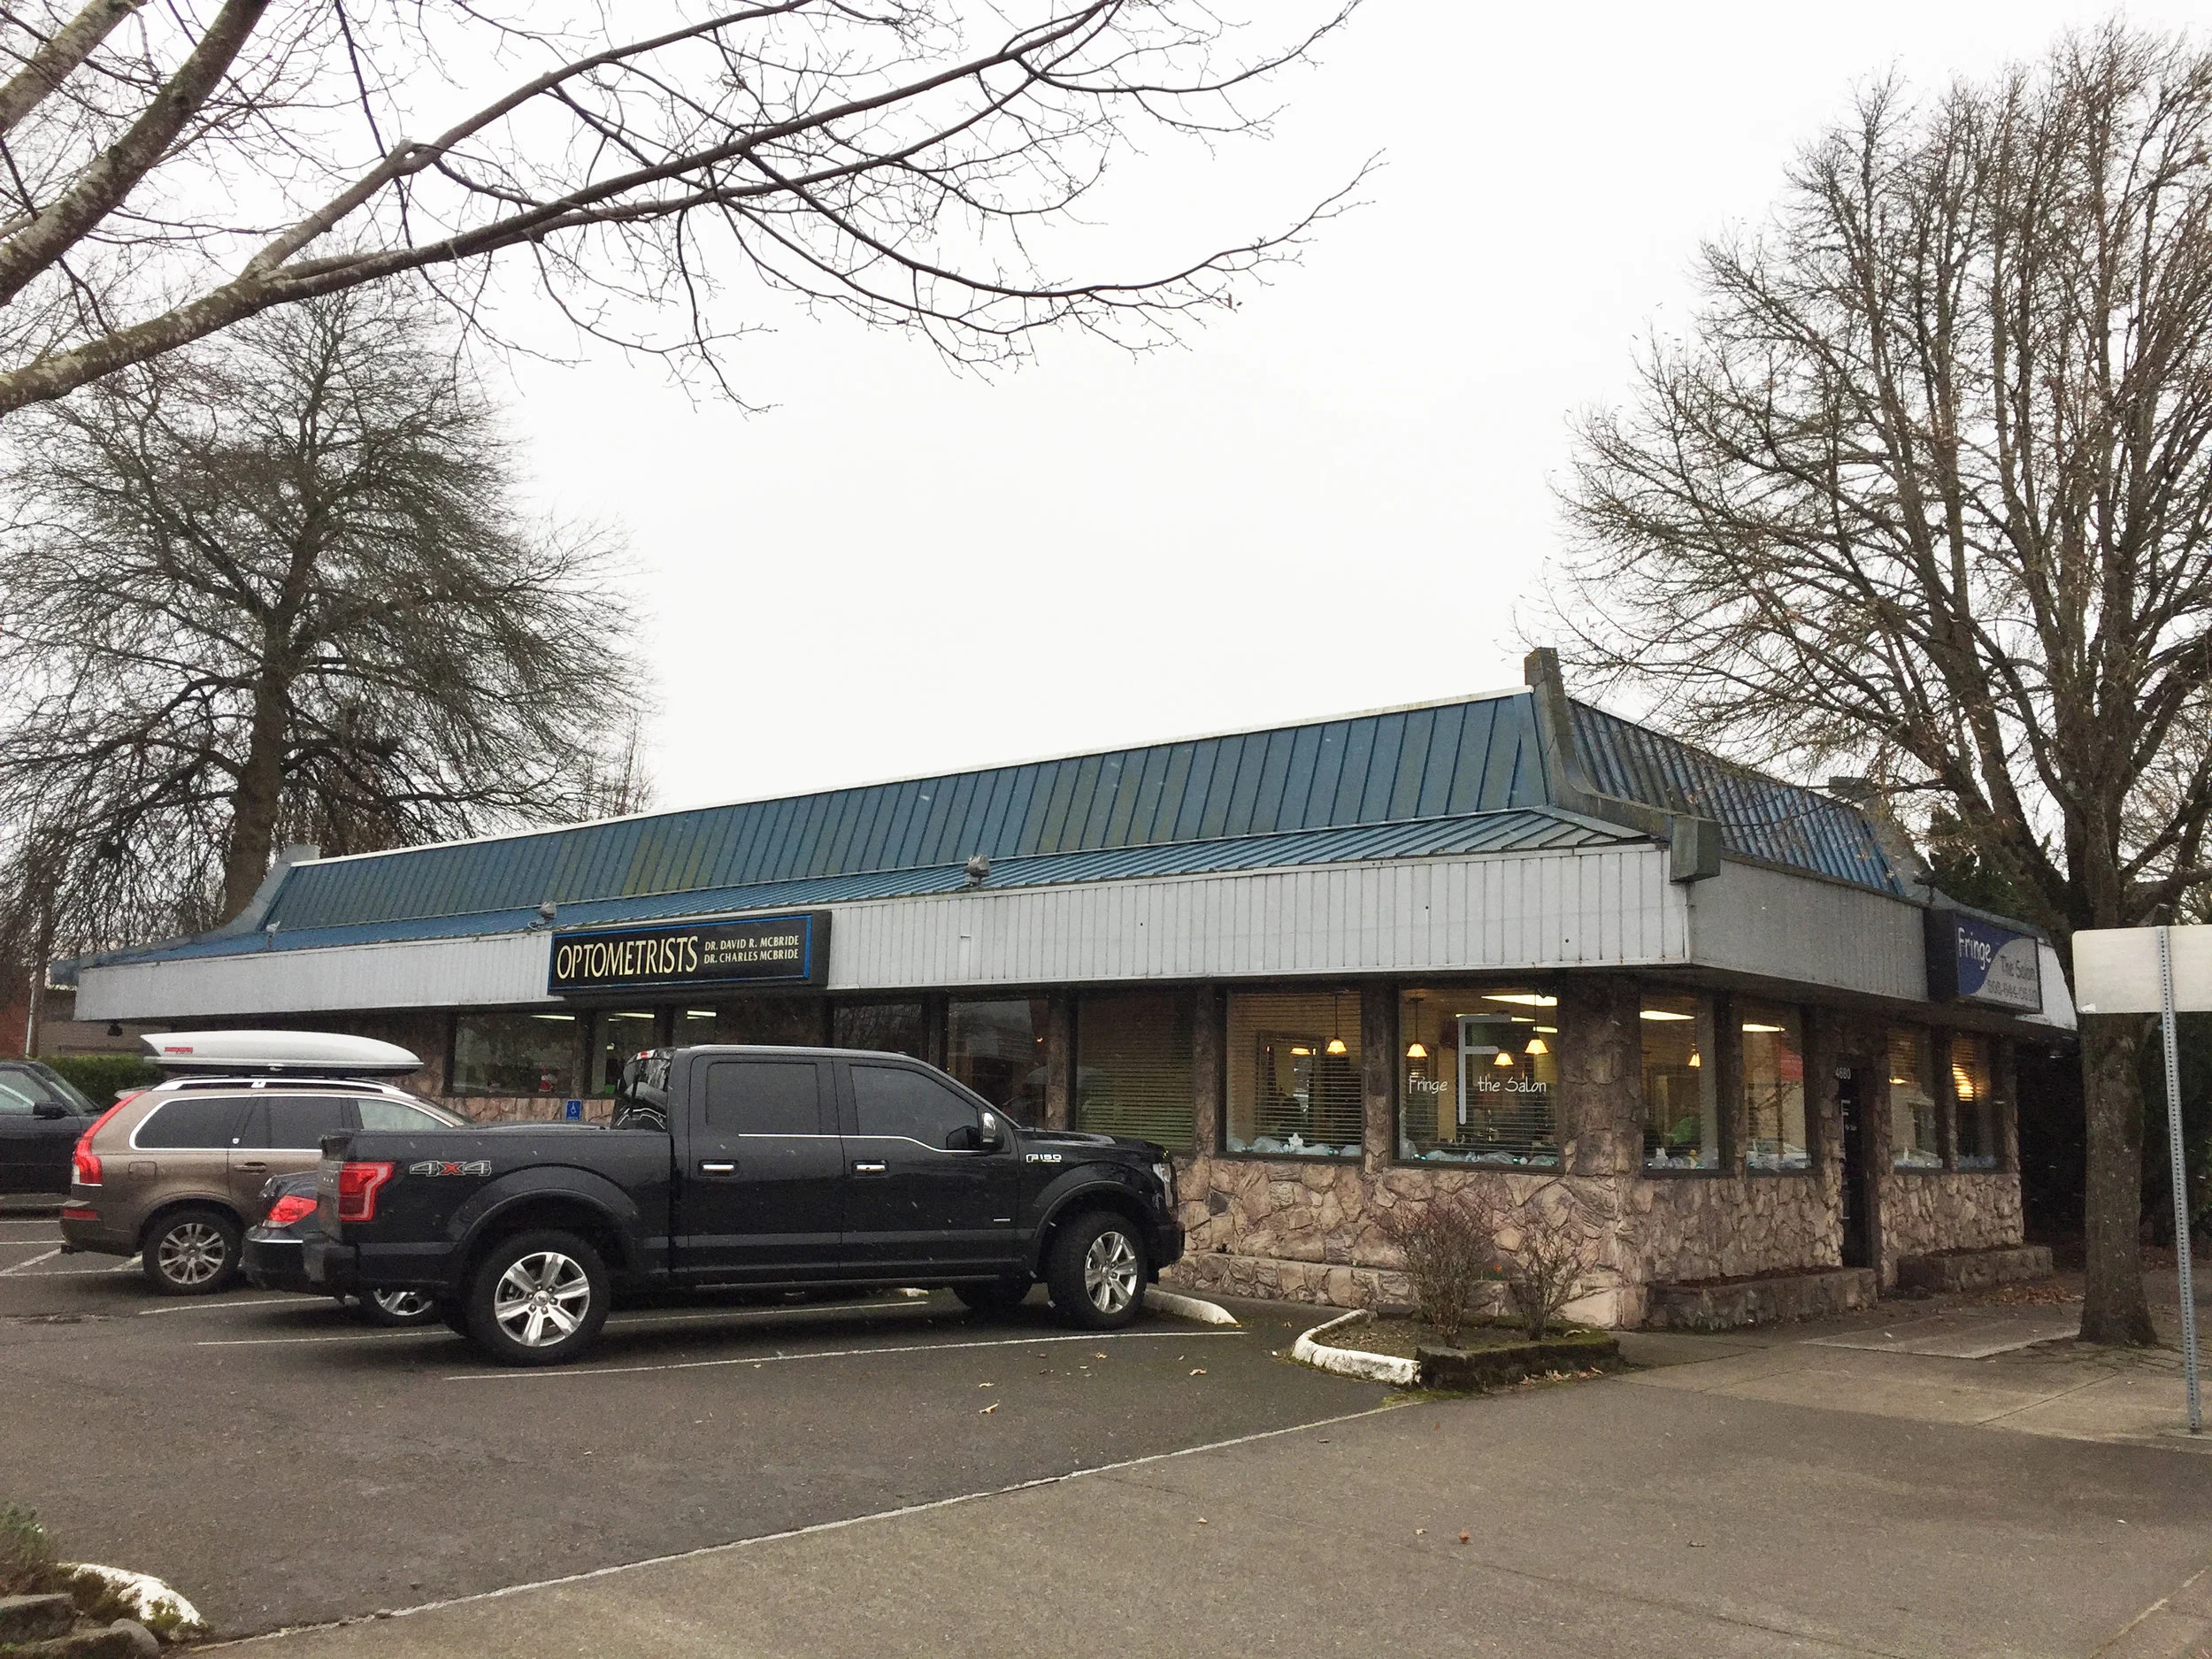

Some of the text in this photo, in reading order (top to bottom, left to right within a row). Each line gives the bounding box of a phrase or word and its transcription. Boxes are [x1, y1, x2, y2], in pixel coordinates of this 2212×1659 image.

[704, 935, 800, 951] DR. DAVID R. MCBRIDE
[1958, 927, 1992, 970] Fringe
[557, 935, 698, 979] OPTOMETRISTS
[703, 949, 799, 964] DR. CHARLES MCBRIDE
[2016, 960, 2037, 981] Salon
[1409, 1075, 1547, 1094] Fringe the Salon
